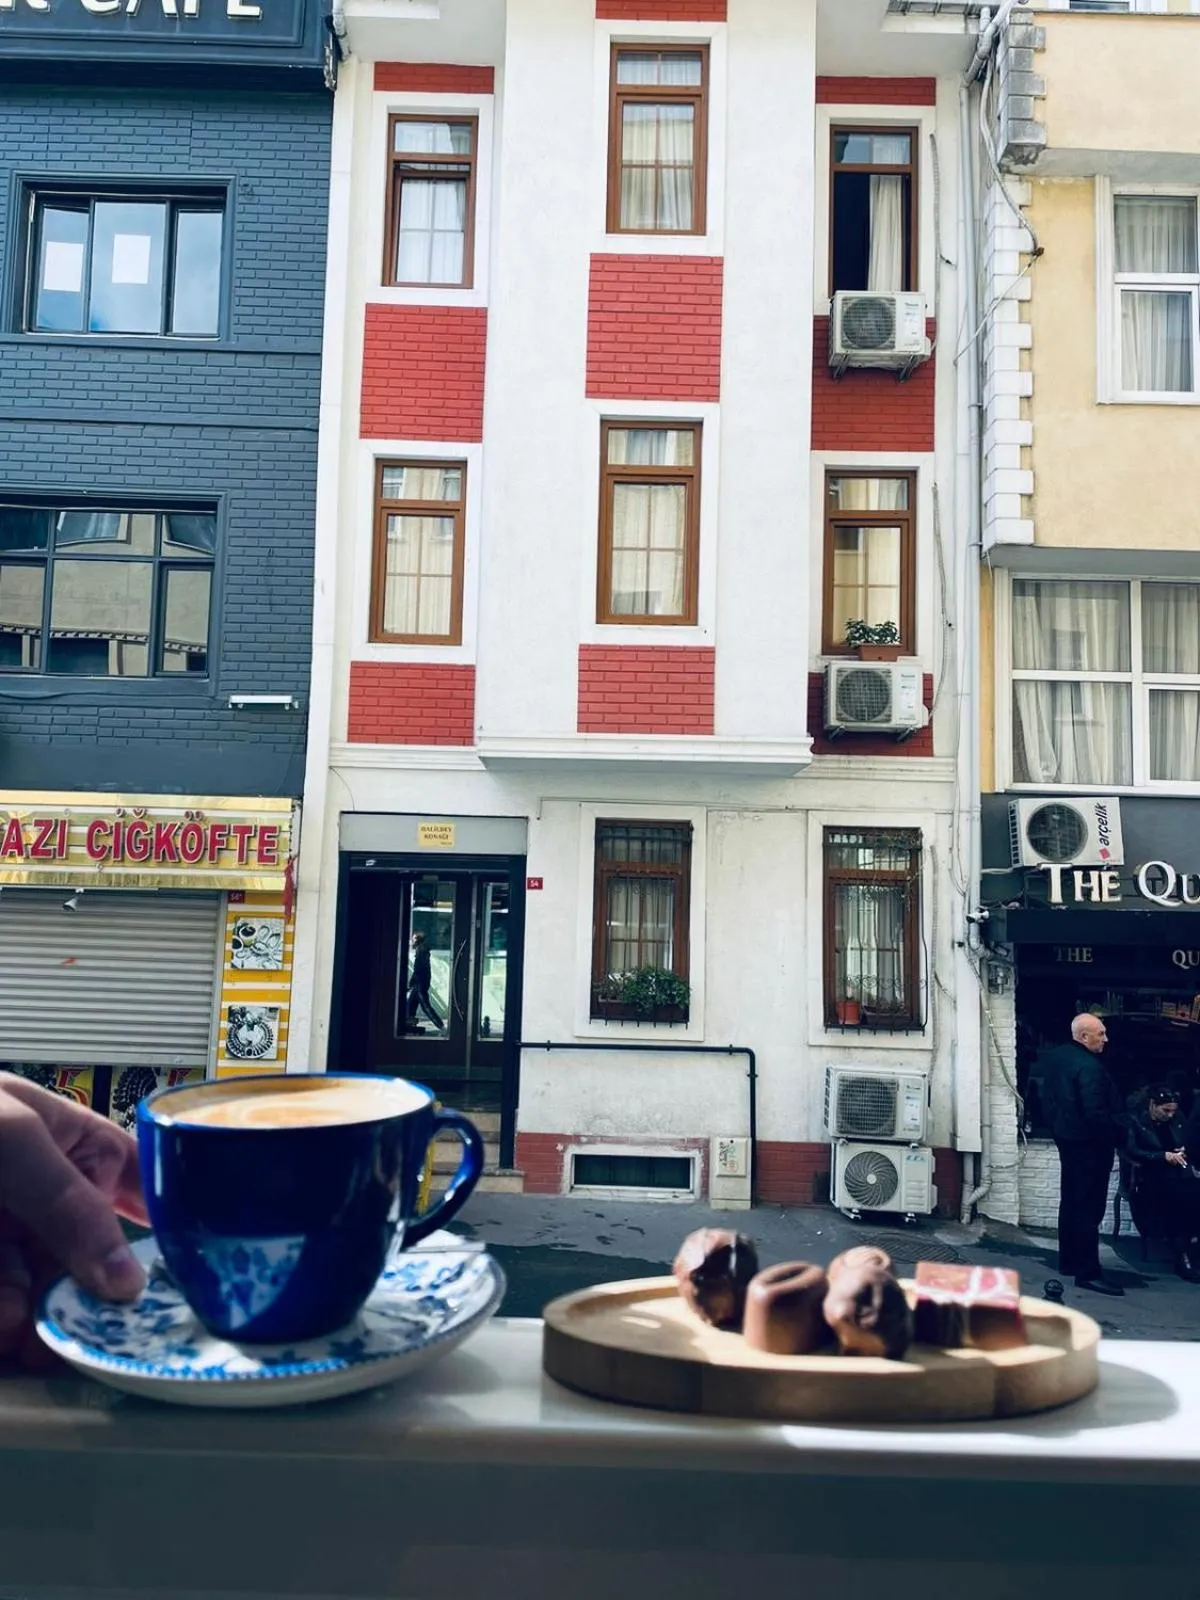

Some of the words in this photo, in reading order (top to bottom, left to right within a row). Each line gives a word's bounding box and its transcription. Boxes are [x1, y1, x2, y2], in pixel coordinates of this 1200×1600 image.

[1094, 802, 1112, 846] arçelik
[1039, 863, 1122, 904] THE
[1054, 947, 1094, 963] THE
